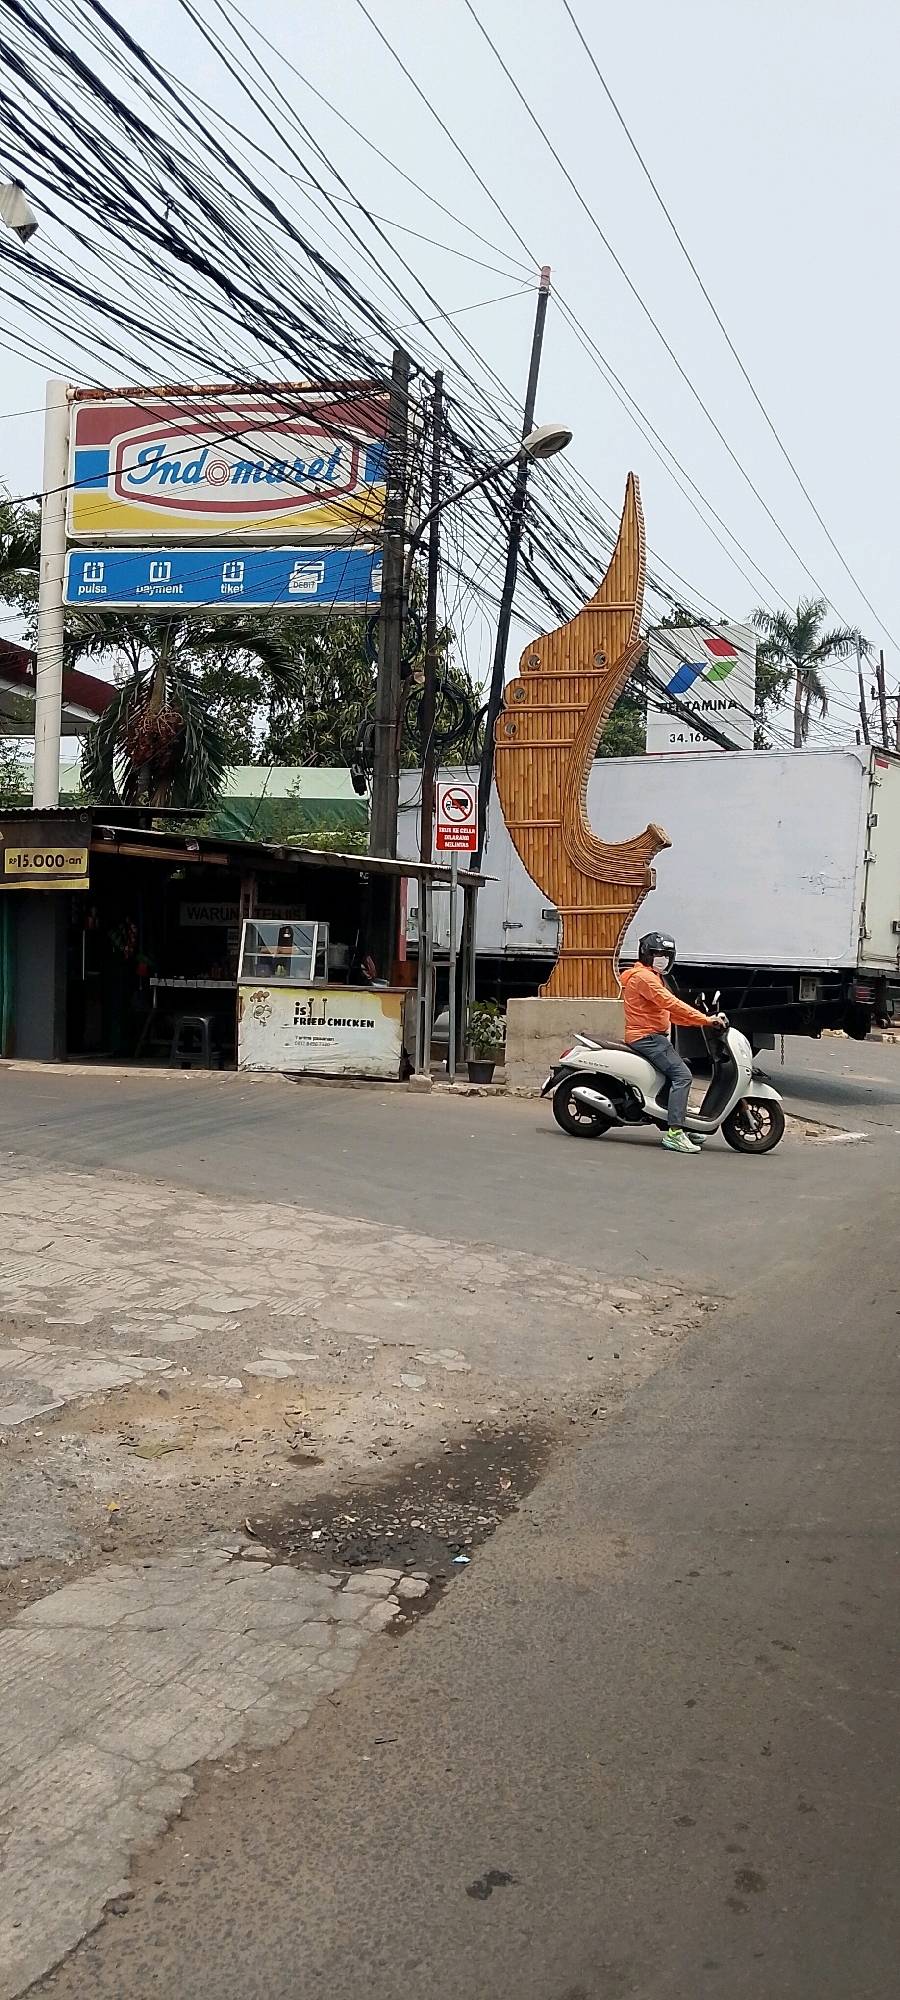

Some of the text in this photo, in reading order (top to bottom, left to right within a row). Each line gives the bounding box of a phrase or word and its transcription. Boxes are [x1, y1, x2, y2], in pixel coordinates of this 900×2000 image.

[127, 444, 344, 486] Indomaret
[78, 583, 244, 596] pulsa payment tiket
[293, 1016, 375, 1028] FRIED CHICKEN
